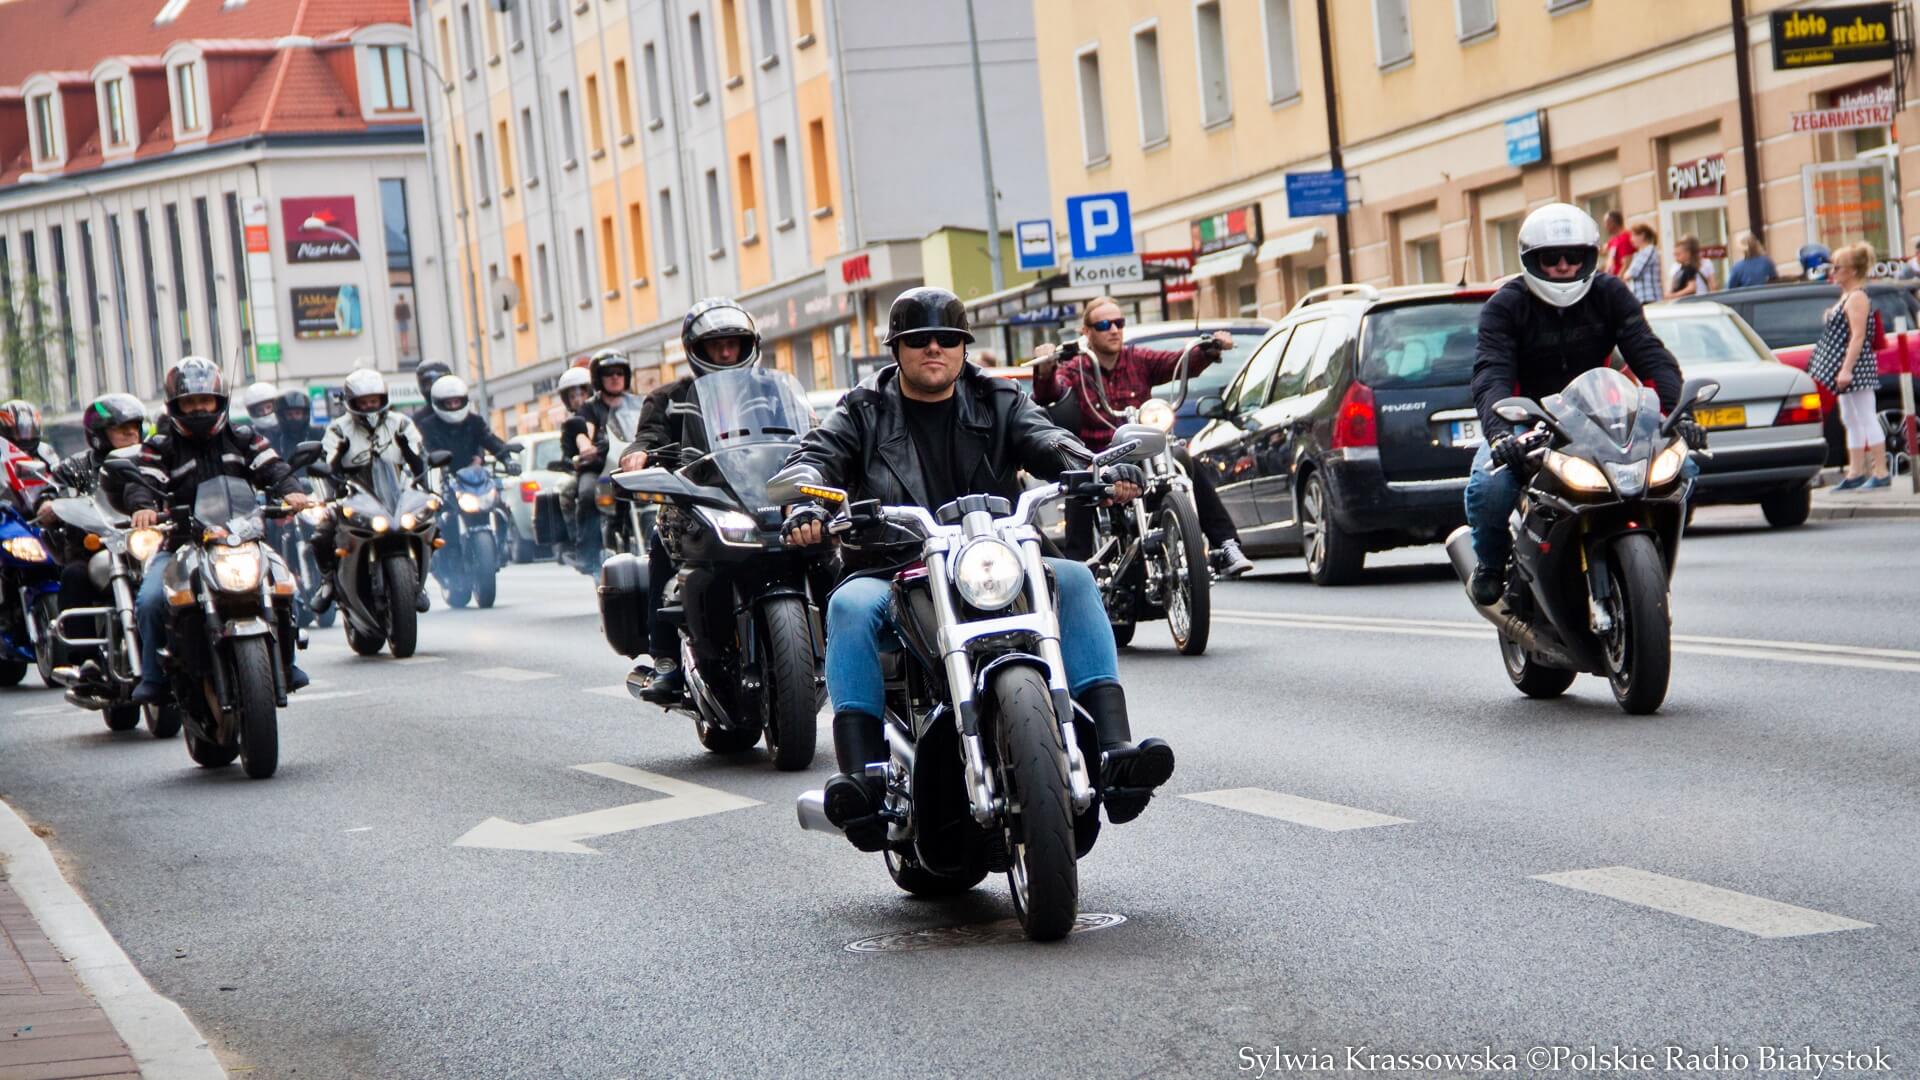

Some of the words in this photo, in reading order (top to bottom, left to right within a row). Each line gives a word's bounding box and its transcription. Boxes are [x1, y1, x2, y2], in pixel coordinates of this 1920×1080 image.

[1832, 17, 1886, 44] srebro
[1792, 106, 1890, 132] ZEGARMISTRZ
[1667, 163, 1697, 200] PANI
[1081, 198, 1119, 252] P
[297, 242, 328, 259] Pizza
[329, 240, 351, 256] Hut
[1074, 264, 1138, 282] Koniec
[1381, 401, 1427, 413] PEUGEOT
